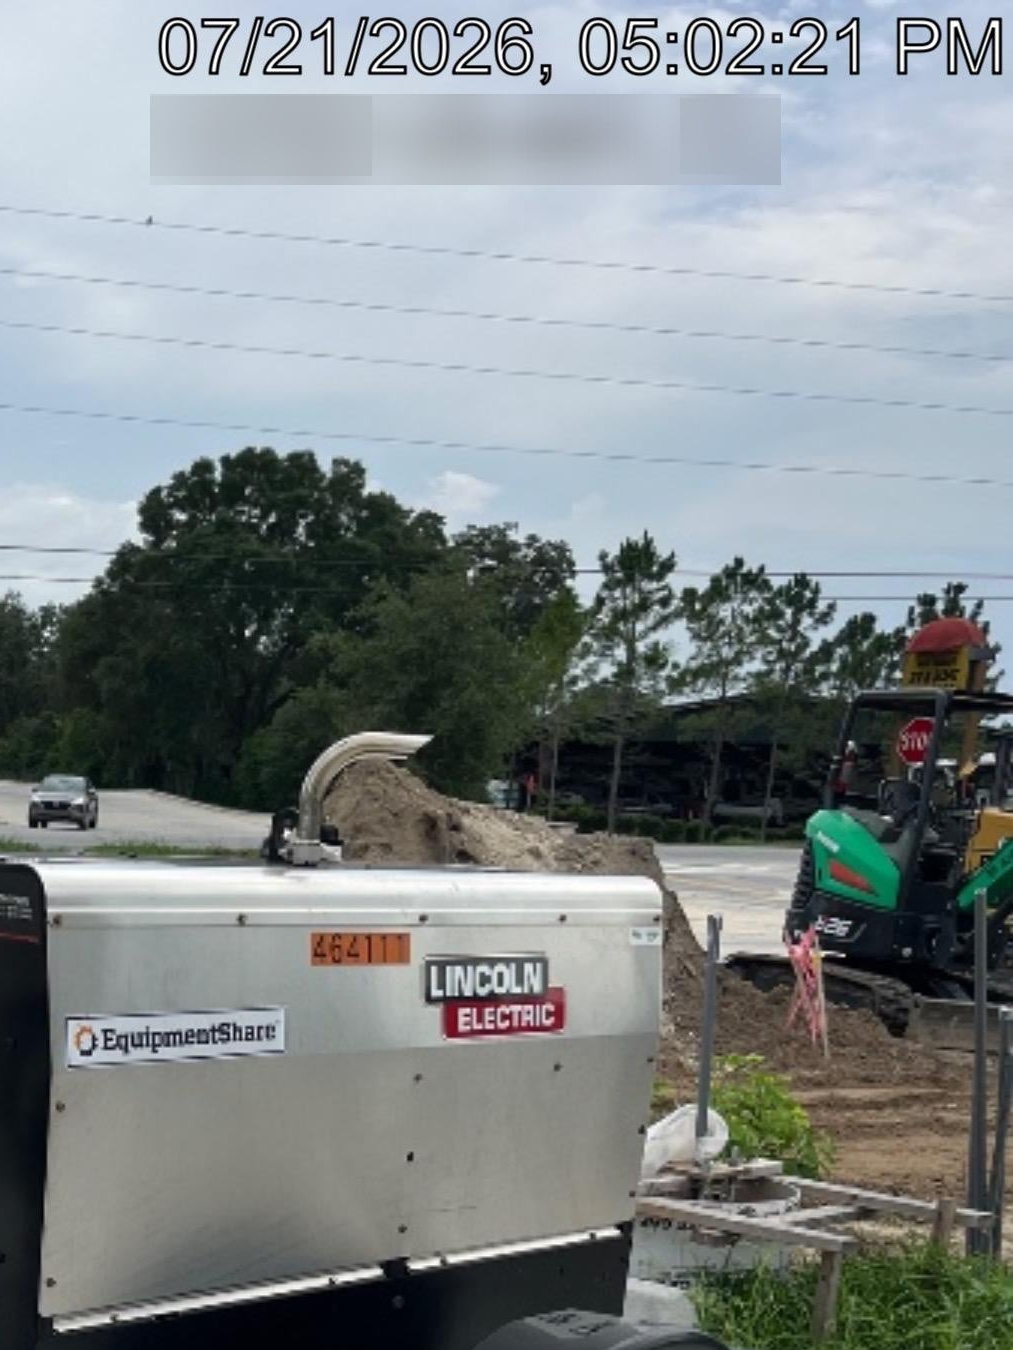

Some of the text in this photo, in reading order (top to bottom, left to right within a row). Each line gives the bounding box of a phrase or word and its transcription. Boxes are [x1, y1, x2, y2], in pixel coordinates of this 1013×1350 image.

[901, 731, 932, 751] STO
[430, 962, 543, 997] LINCOLN
[457, 1002, 556, 1033] ELECTRIC
[101, 1021, 276, 1054] EquipmentShare
